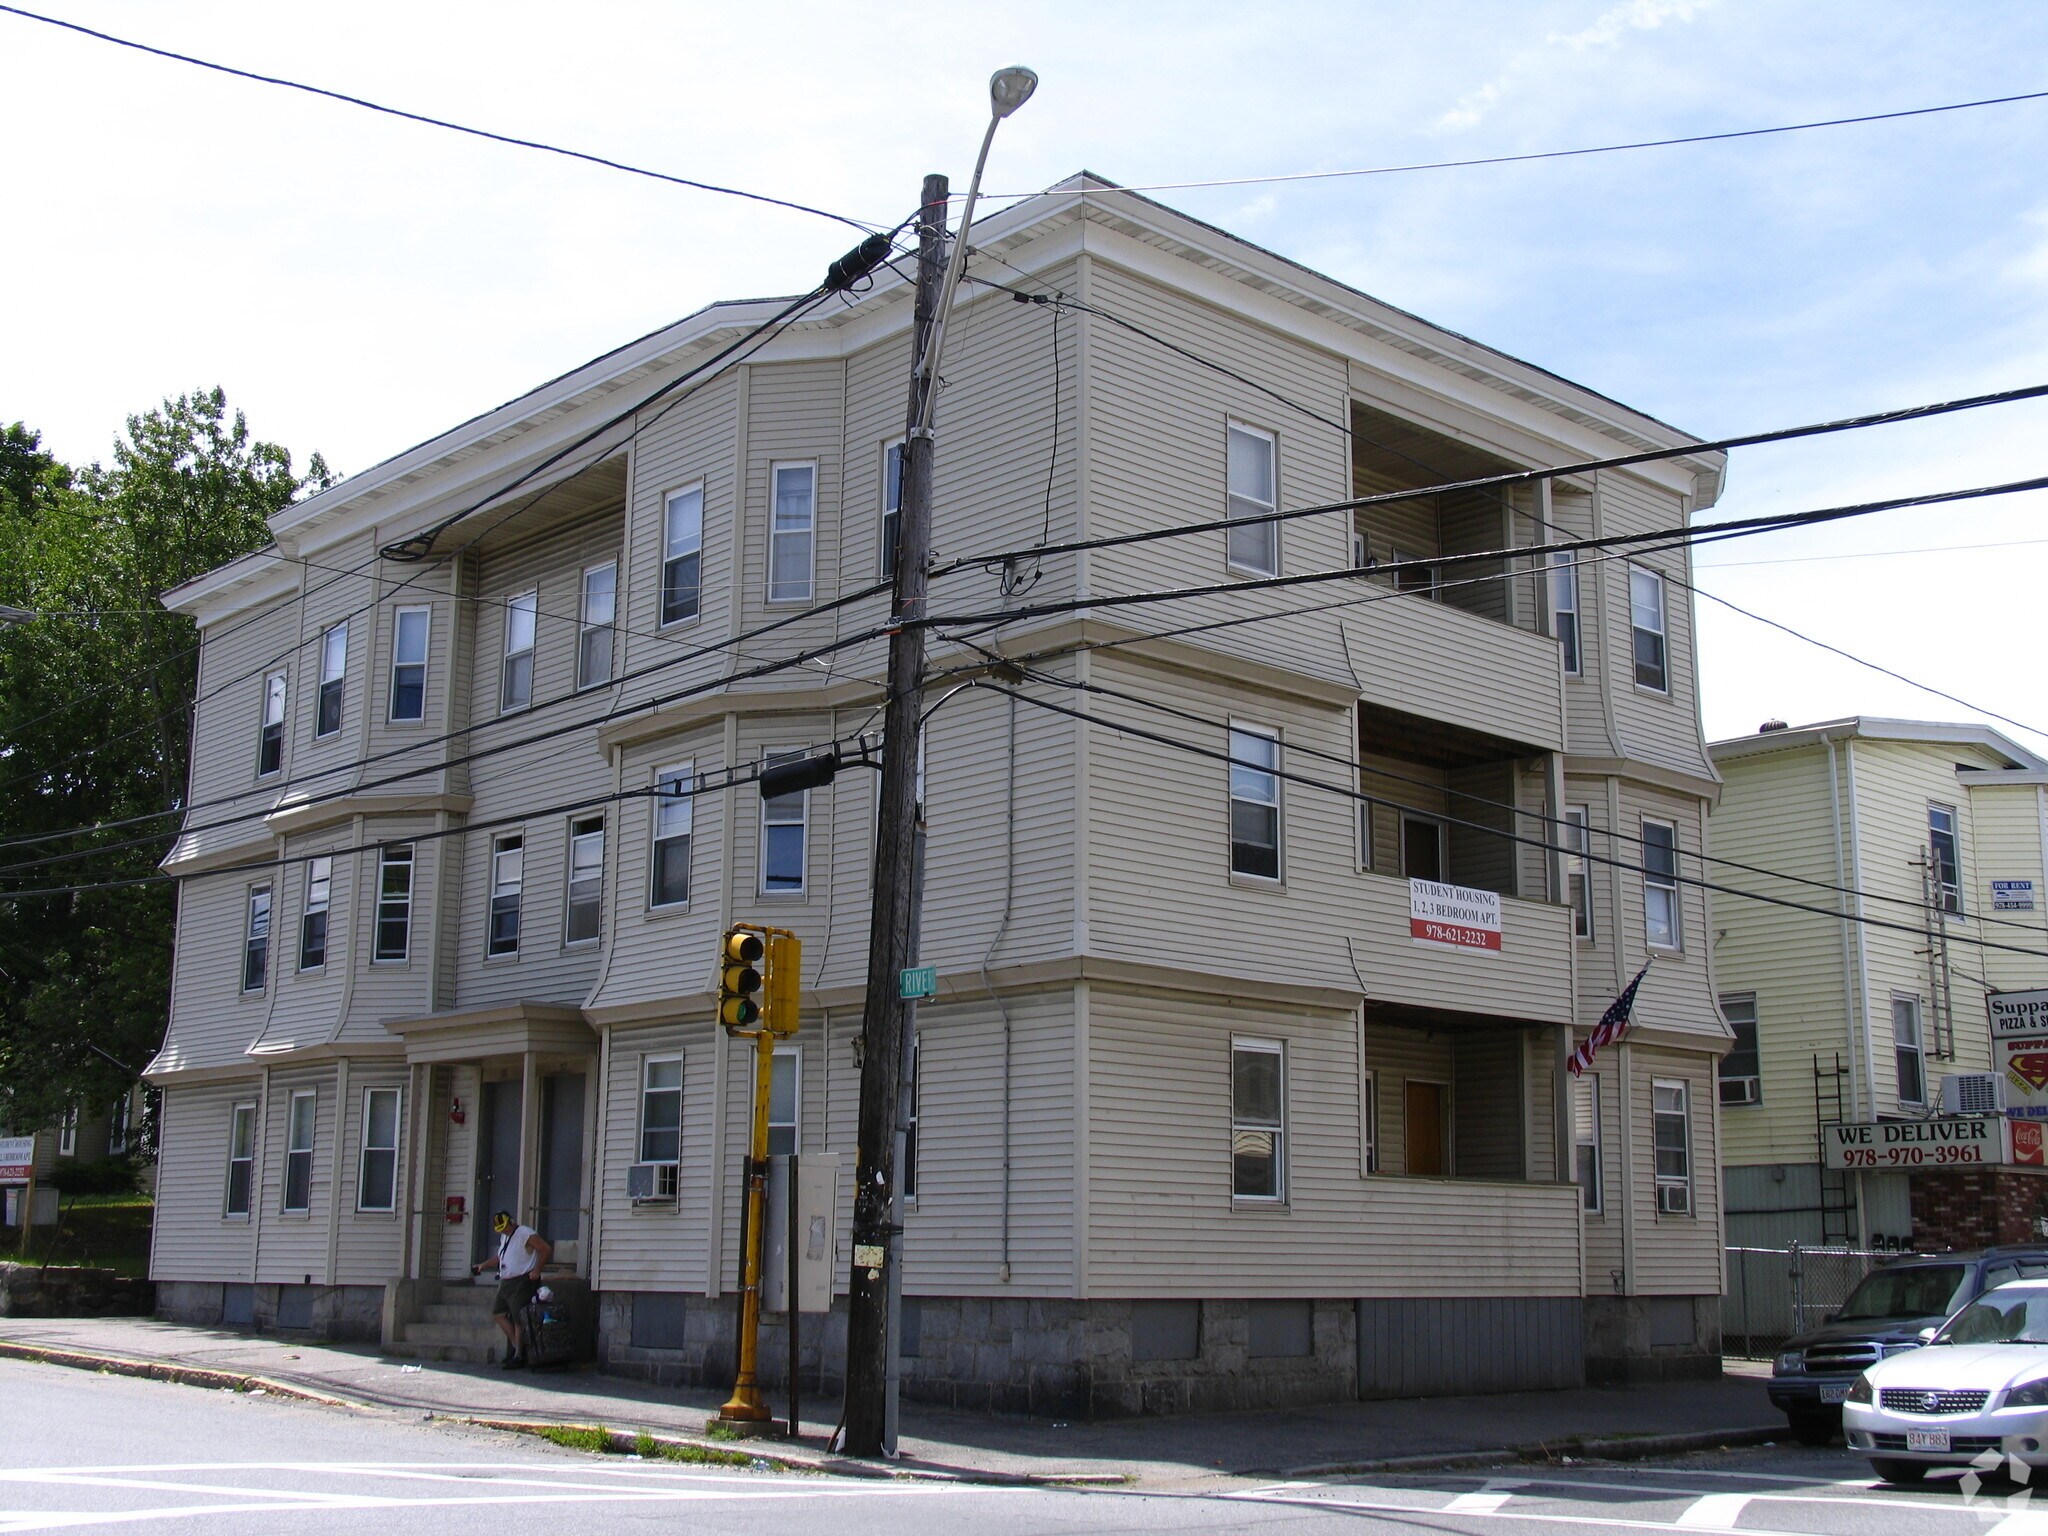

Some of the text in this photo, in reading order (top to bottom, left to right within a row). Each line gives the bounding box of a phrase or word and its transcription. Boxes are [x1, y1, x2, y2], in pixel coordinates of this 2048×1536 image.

[1413, 881, 1495, 906] STUDENT HOUSING
[1413, 900, 1498, 925] 1, 2, 3 BEDROOM APT.
[1426, 923, 1486, 946] 978-621-2232
[1999, 1017, 2026, 1030] PIZZA
[2030, 1016, 2037, 1028] &
[1837, 1121, 1988, 1144] WE DELIVER
[1843, 1144, 1983, 1167] 978-970-3961
